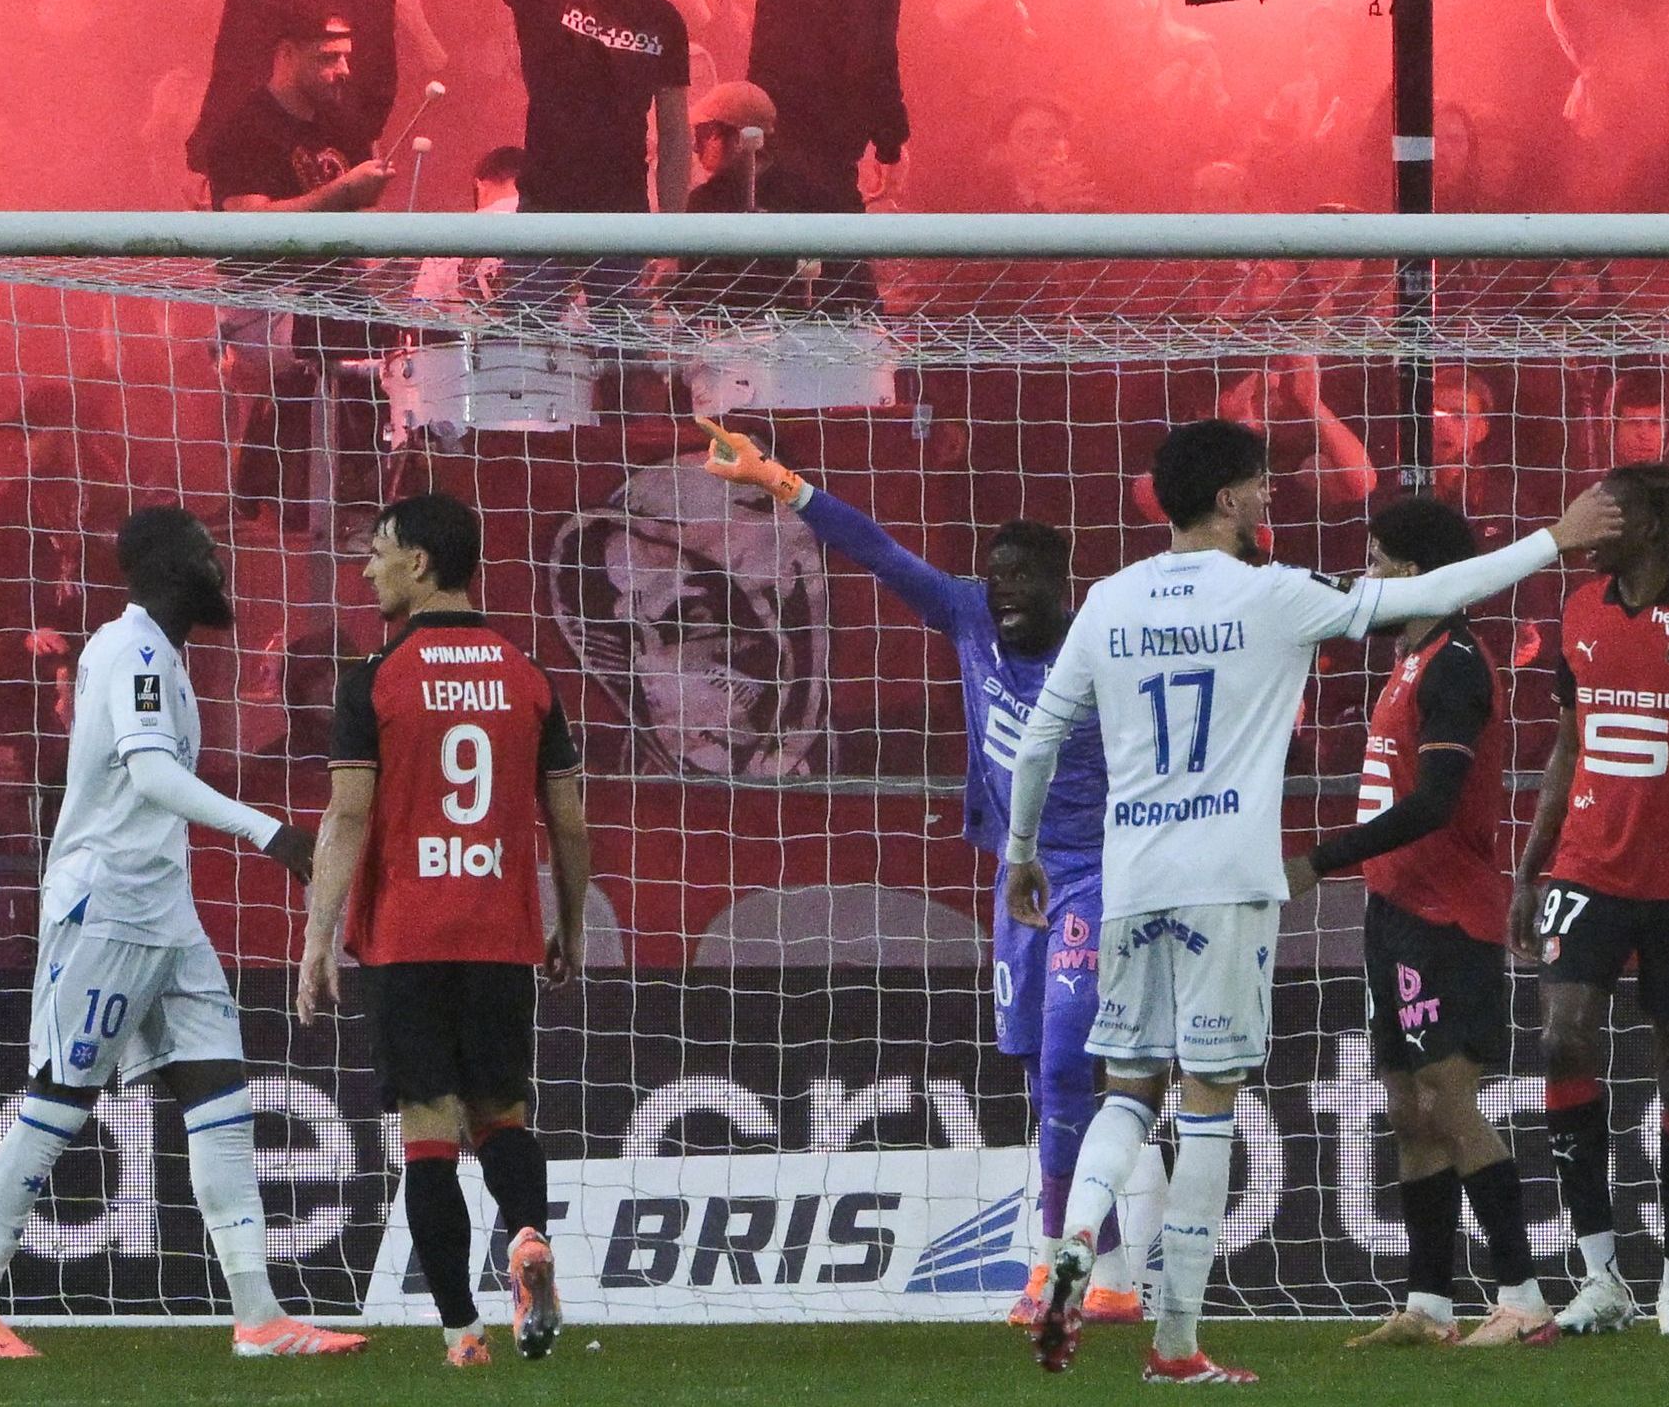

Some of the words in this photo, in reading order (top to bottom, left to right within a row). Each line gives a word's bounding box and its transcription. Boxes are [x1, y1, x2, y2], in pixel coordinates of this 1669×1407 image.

[419, 645, 504, 664] WINAMAX
[1109, 628, 1133, 658] EL
[1140, 621, 1245, 657] AZZOUZI
[421, 680, 511, 711] LEPAUL
[1138, 668, 1216, 775] 17
[441, 723, 493, 825] 9
[1540, 888, 1590, 935] 97
[84, 989, 129, 1039] 10
[1399, 997, 1441, 1032] WT
[597, 1191, 902, 1290] BRIS
